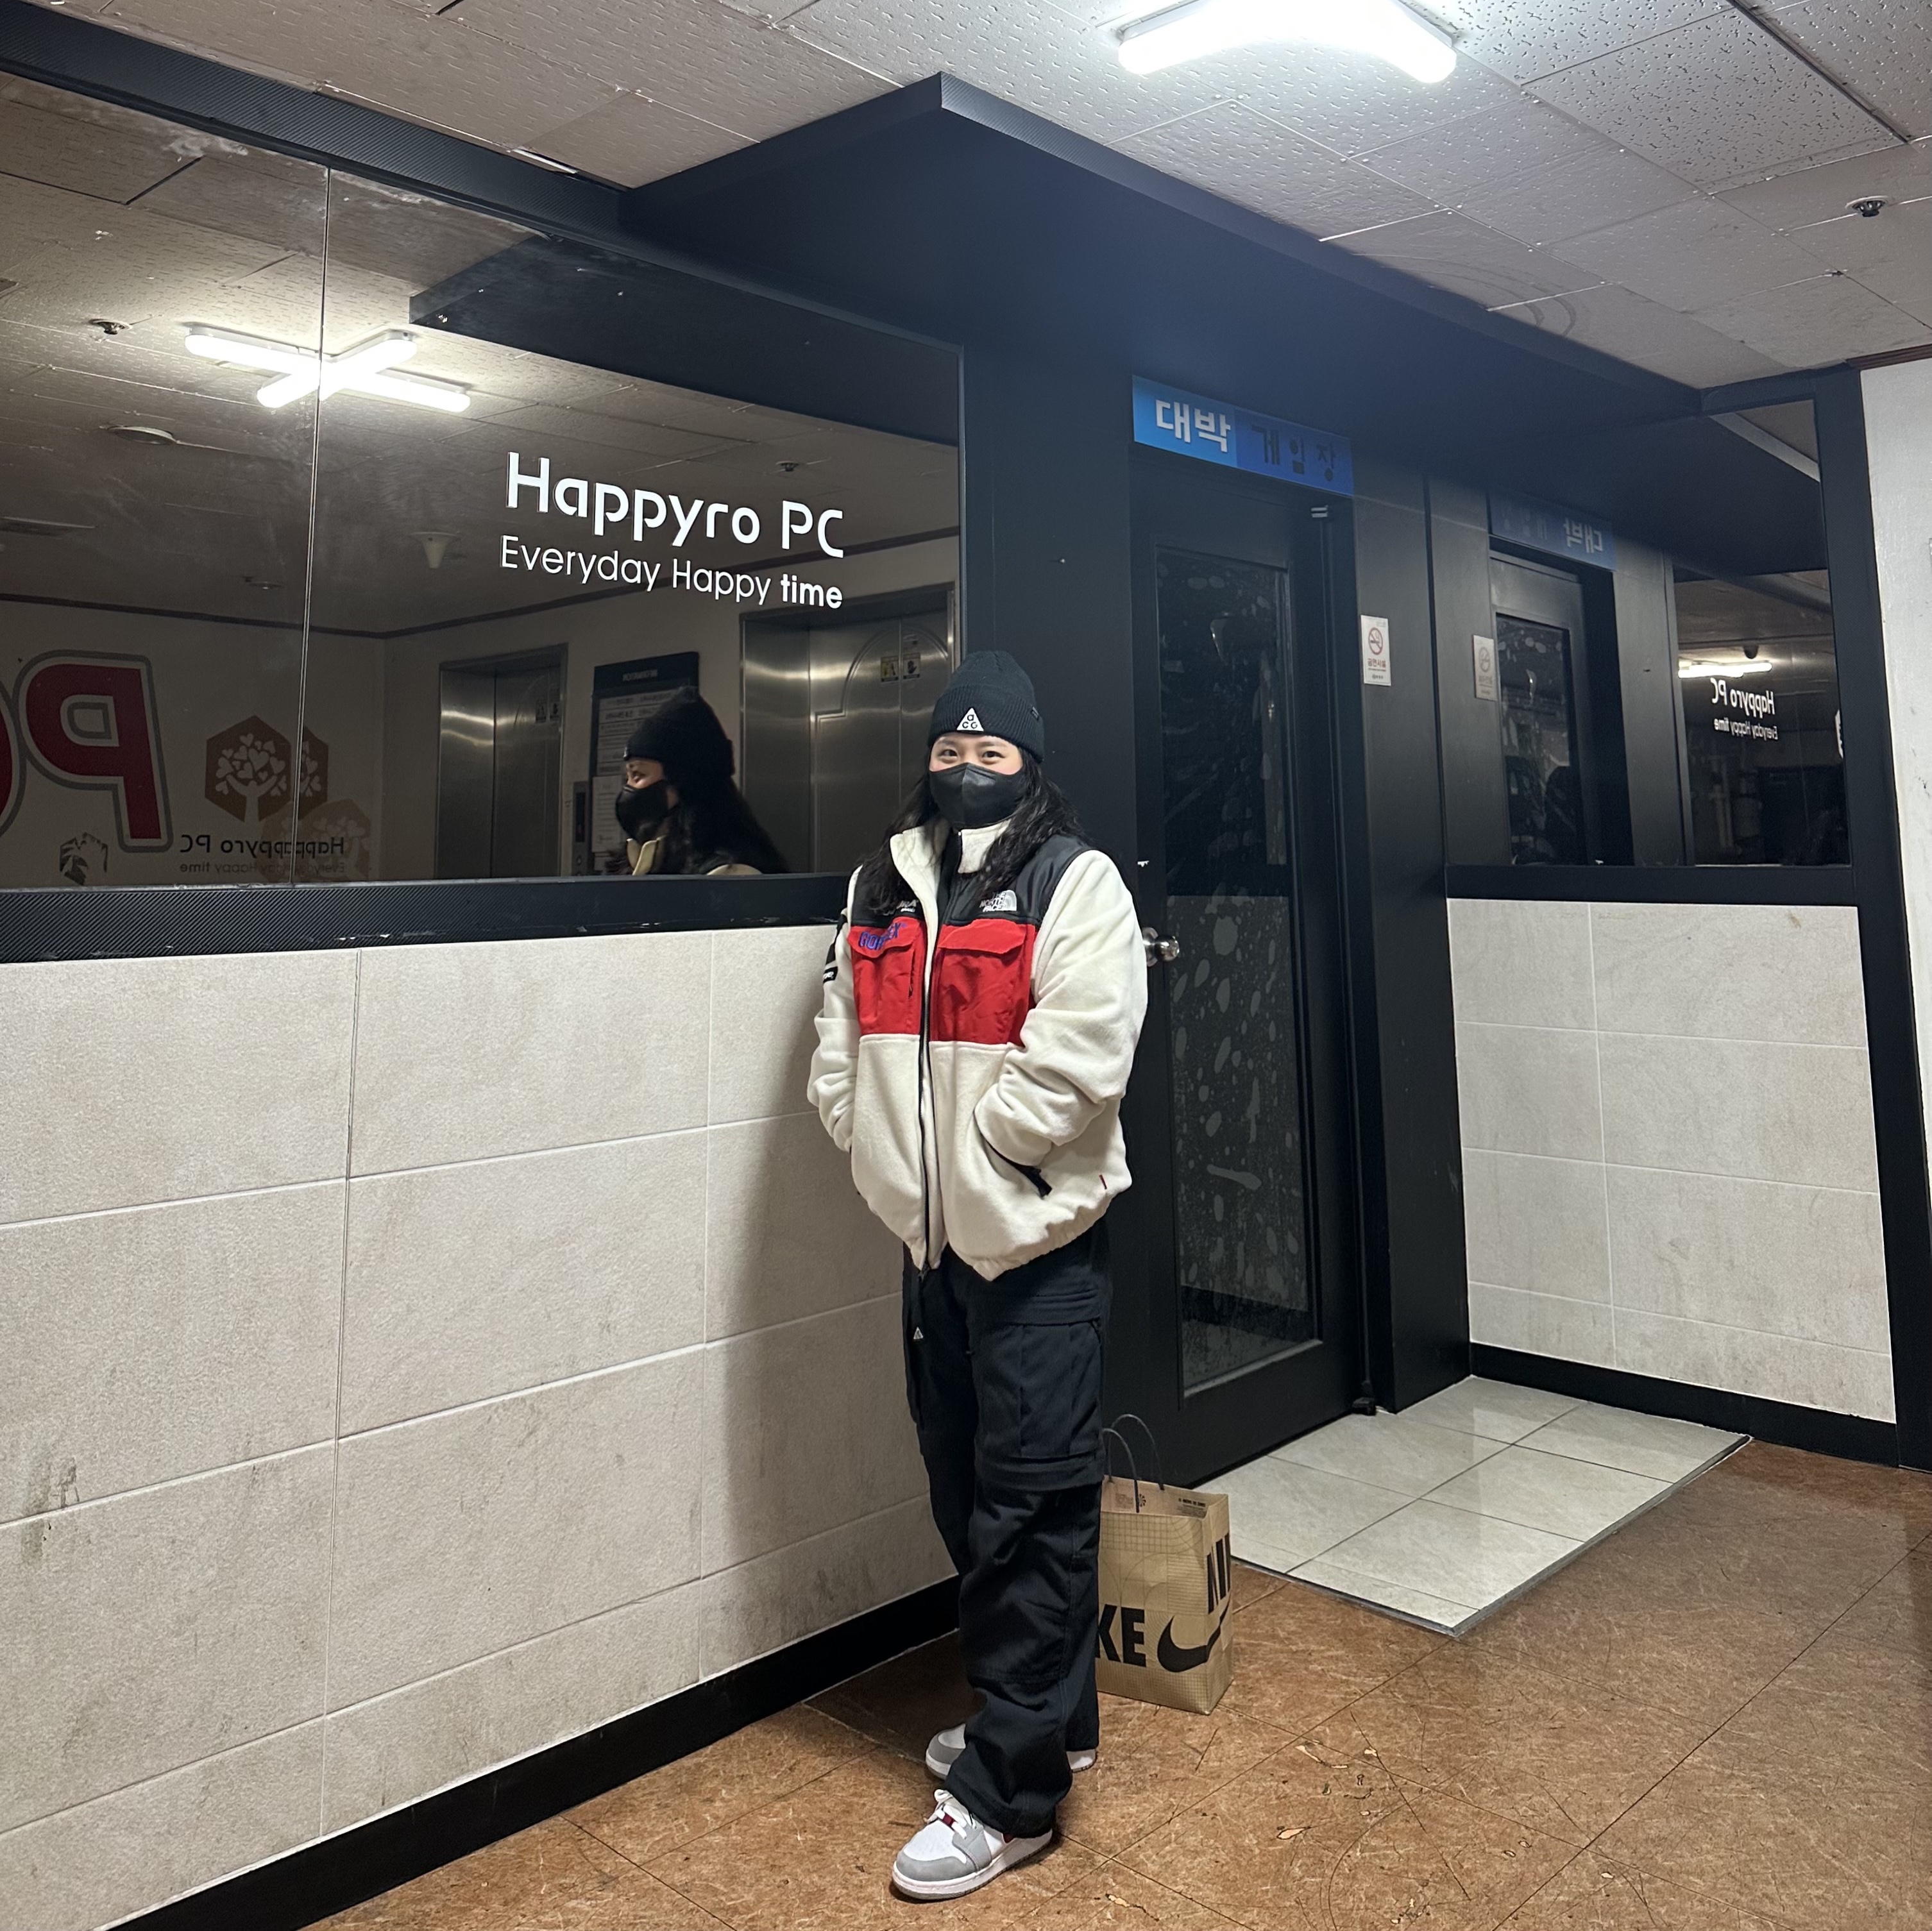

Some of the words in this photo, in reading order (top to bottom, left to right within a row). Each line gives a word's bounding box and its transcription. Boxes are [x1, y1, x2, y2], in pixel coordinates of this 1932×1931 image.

[1155, 399, 1231, 453] 대박
[505, 451, 760, 547] Happyro
[781, 500, 844, 559] PC
[500, 535, 661, 592] Everyday
[672, 558, 771, 605] Happy
[780, 573, 843, 609] time
[1096, 1603, 1146, 1667] KE
